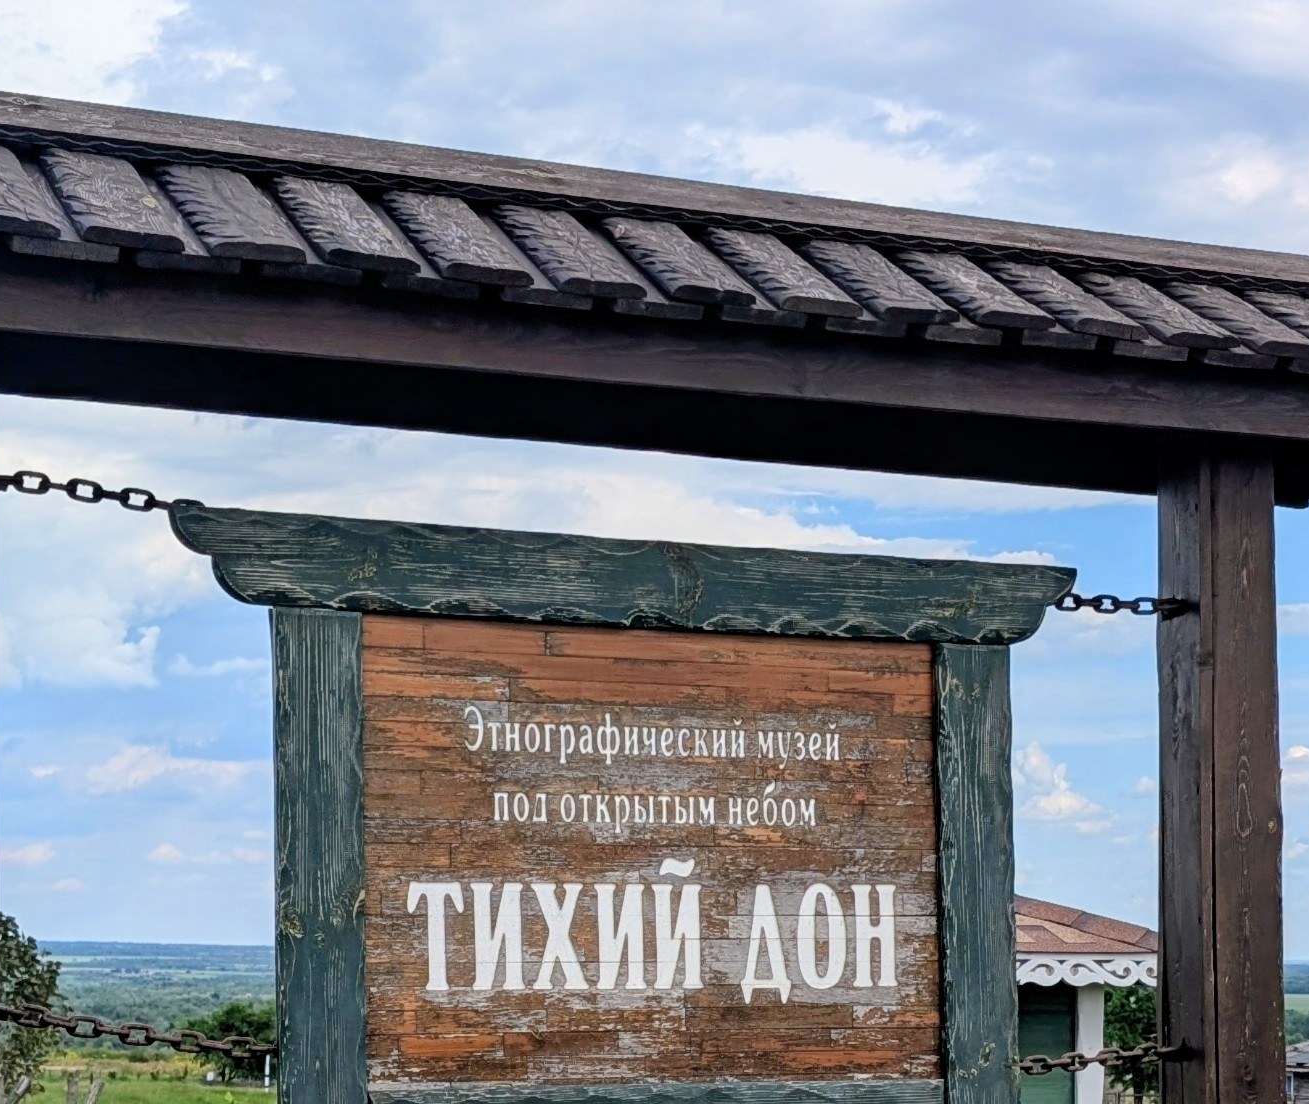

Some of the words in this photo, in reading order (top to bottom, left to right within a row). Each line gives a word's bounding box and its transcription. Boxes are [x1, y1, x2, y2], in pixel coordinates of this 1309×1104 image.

[462, 705, 746, 764] Этнографический
[756, 721, 841, 769] музей
[493, 789, 549, 823] под
[560, 793, 716, 833] открытым
[728, 782, 817, 827] небом
[406, 858, 704, 991] ТИХИЙ
[740, 884, 898, 1004] ДОН
